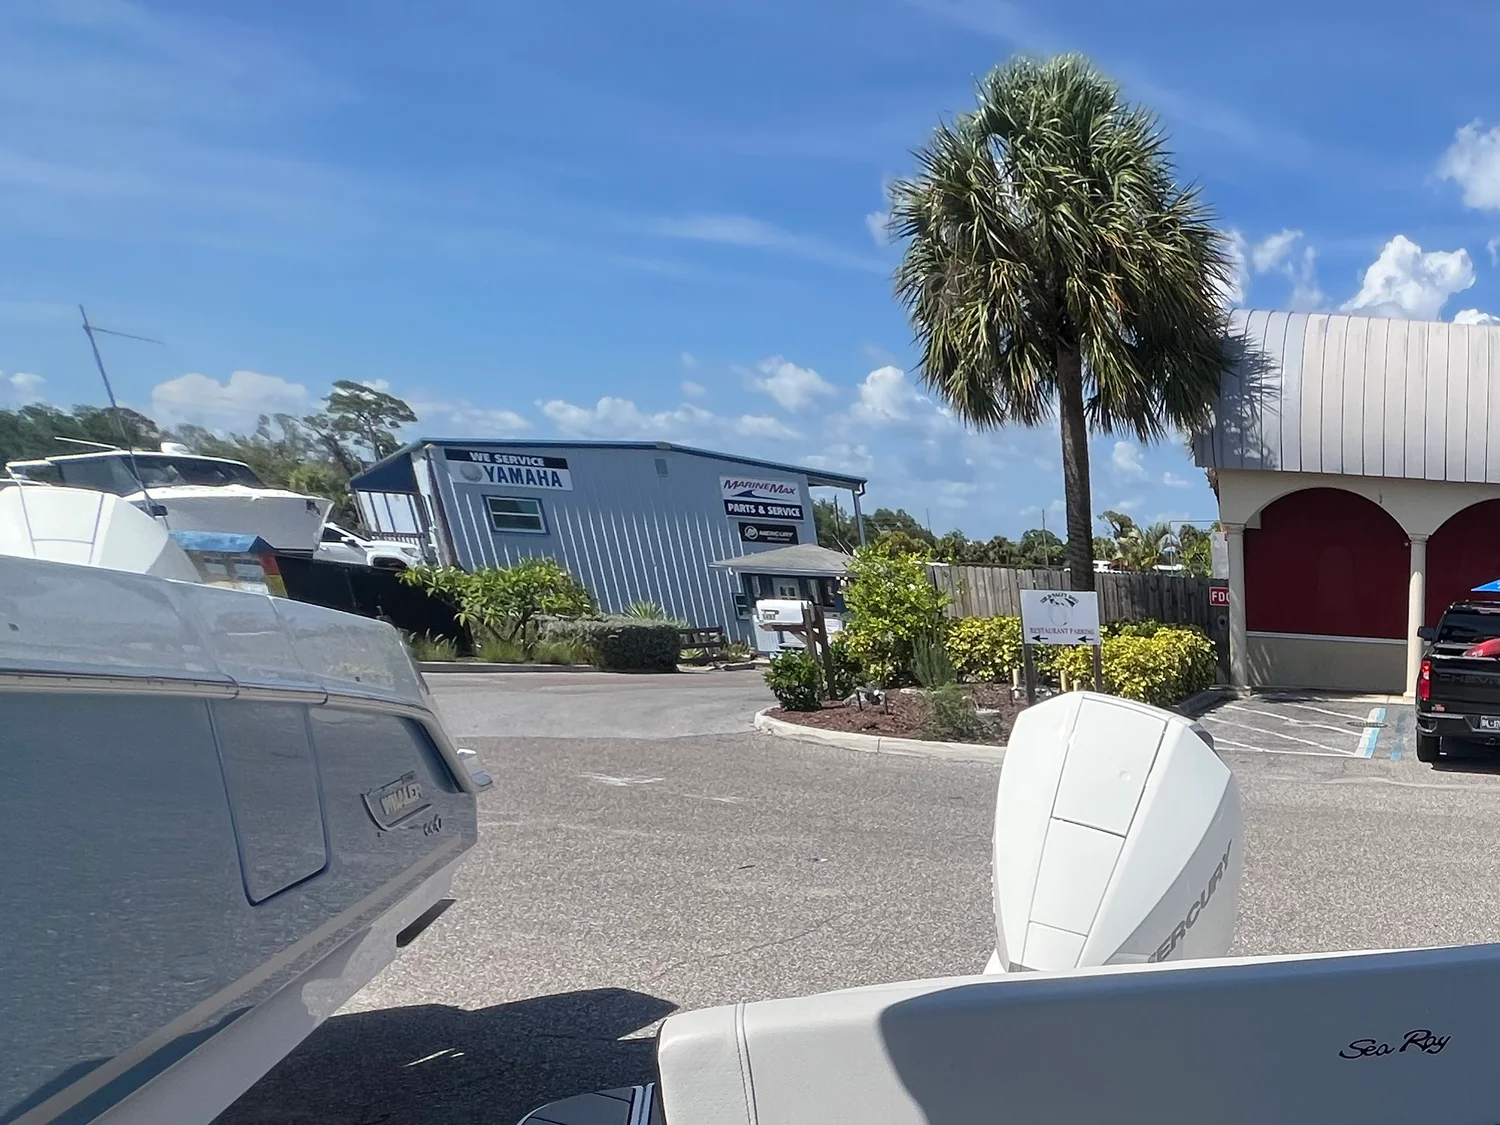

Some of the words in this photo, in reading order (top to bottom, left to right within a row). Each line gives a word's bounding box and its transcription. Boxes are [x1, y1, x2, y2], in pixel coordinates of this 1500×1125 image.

[469, 452, 491, 462] WE
[494, 453, 546, 467] SERVICE
[483, 465, 563, 488] YAMAHA
[727, 503, 756, 514] PARTS
[758, 505, 766, 514] &
[767, 505, 801, 516] SERVICE
[759, 530, 794, 538] MERCURY
[1339, 1038, 1396, 1059] Sea
[1399, 1029, 1452, 1055] Ray
